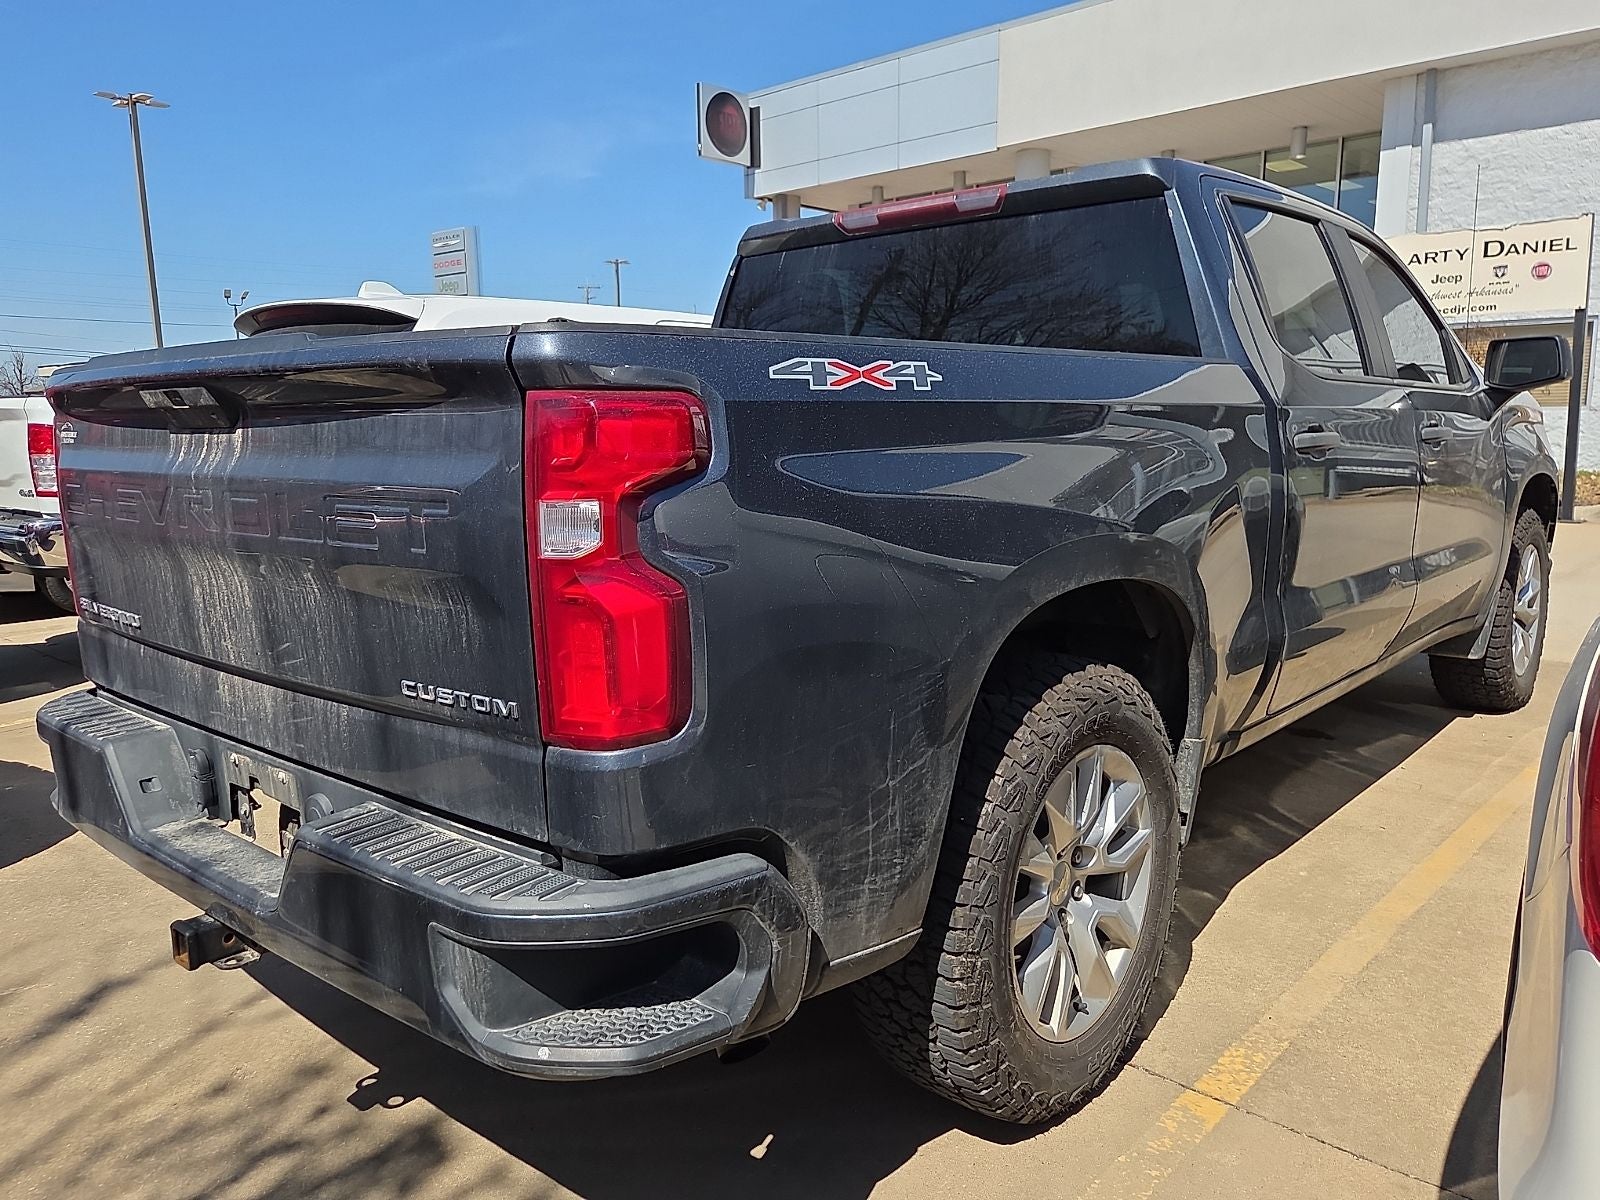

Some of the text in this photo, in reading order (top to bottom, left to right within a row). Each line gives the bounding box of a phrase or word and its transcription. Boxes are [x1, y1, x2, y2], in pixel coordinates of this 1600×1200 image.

[1483, 237, 1578, 258] DANIEL
[434, 259, 462, 269] DODGE
[440, 279, 459, 293] Jeep
[1431, 274, 1463, 285] Jeep
[400, 679, 519, 719] CUSTOM
